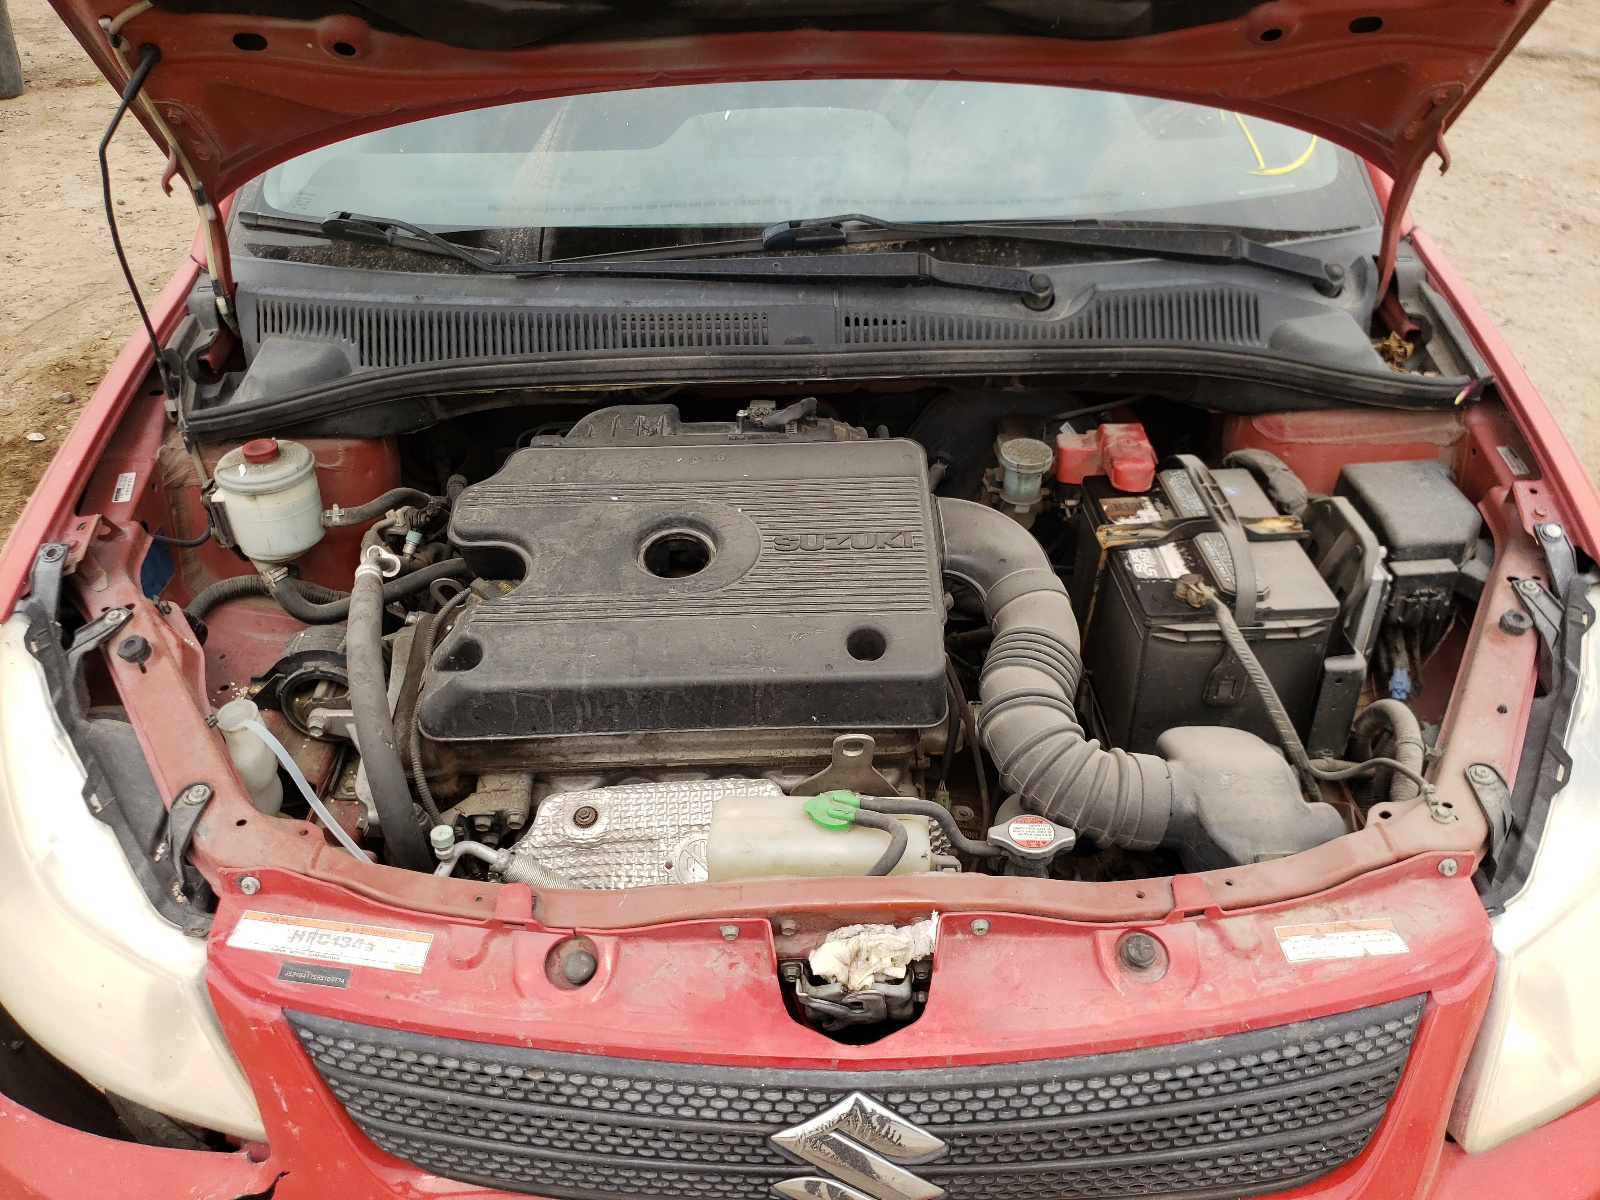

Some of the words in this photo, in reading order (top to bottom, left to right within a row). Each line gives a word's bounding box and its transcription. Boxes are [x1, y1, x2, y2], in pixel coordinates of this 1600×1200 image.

[773, 531, 914, 552] SUZUKI
[1129, 549, 1143, 573] SUPE
[289, 929, 375, 953] HFC134a
